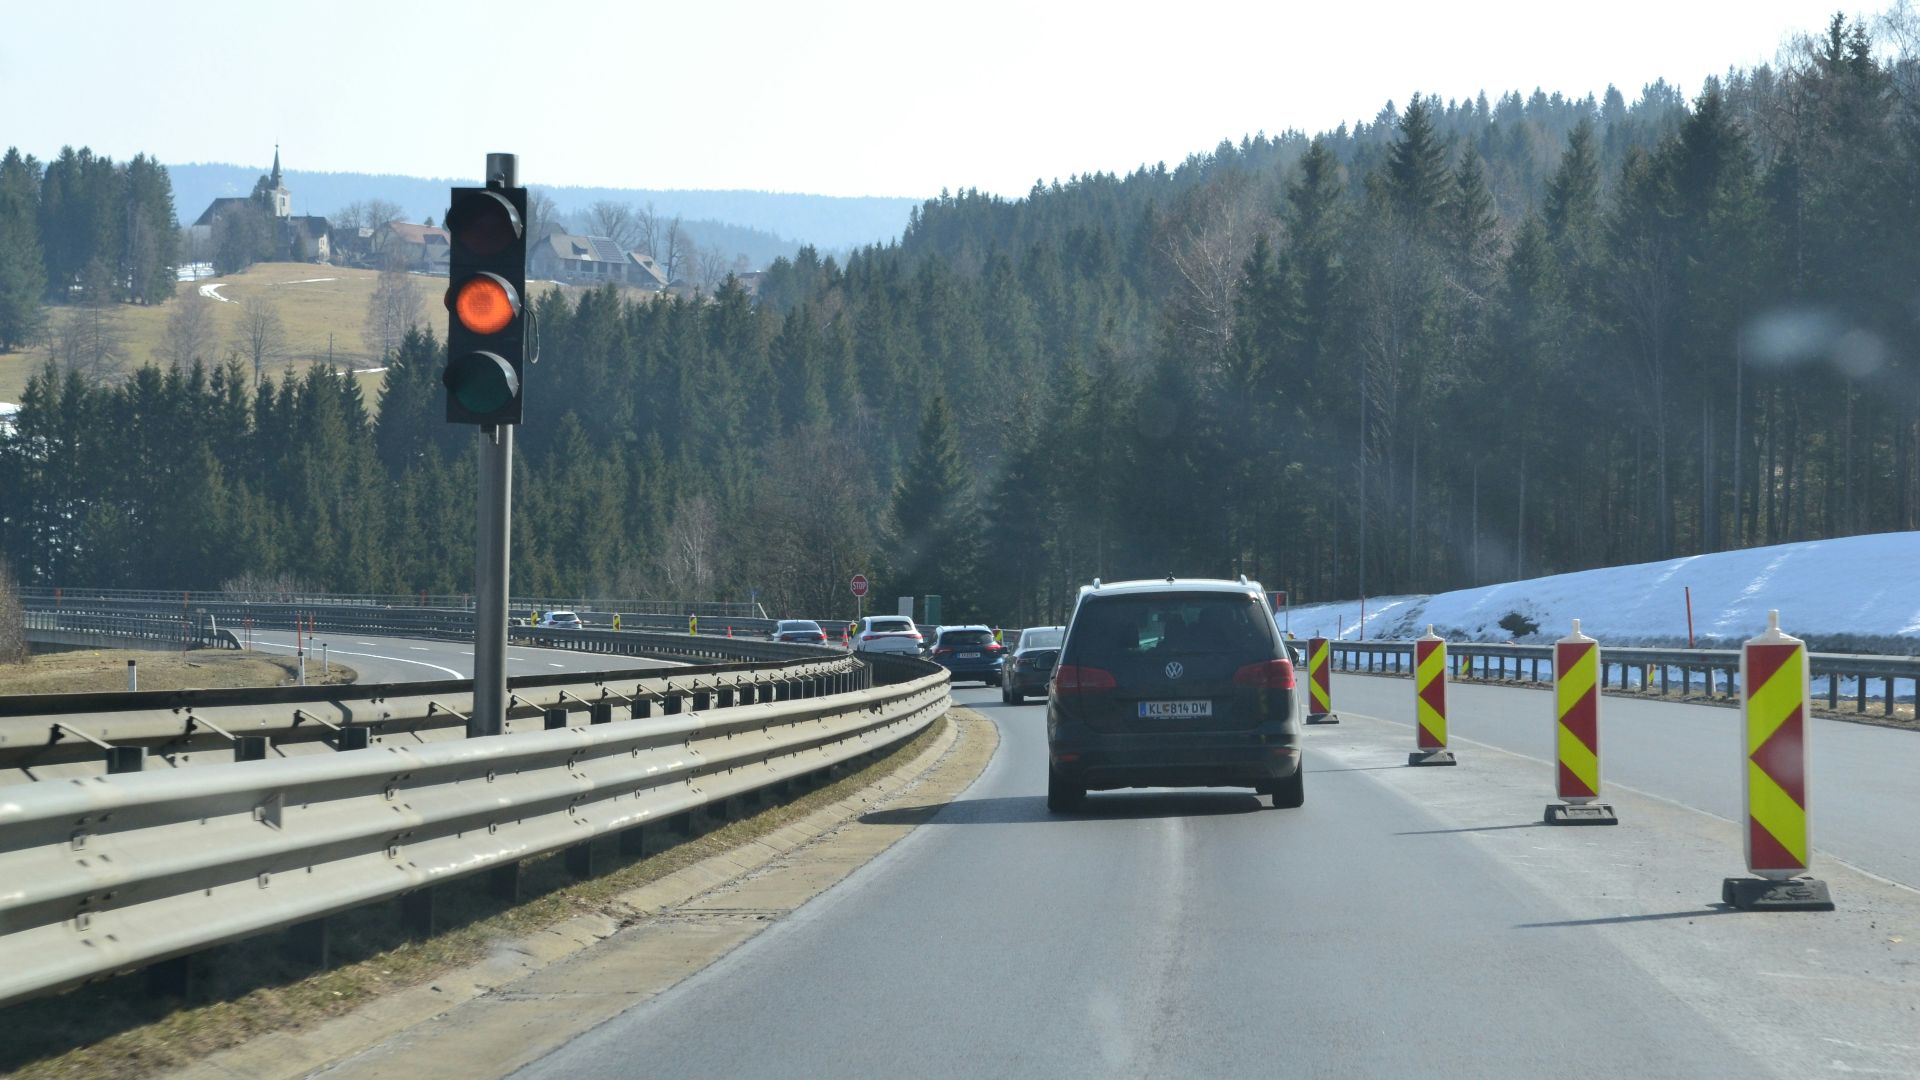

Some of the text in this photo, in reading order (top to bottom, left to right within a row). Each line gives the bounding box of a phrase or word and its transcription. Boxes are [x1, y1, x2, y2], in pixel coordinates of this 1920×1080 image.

[852, 581, 866, 590] STOP
[1149, 702, 1208, 714] KL 814 DW
